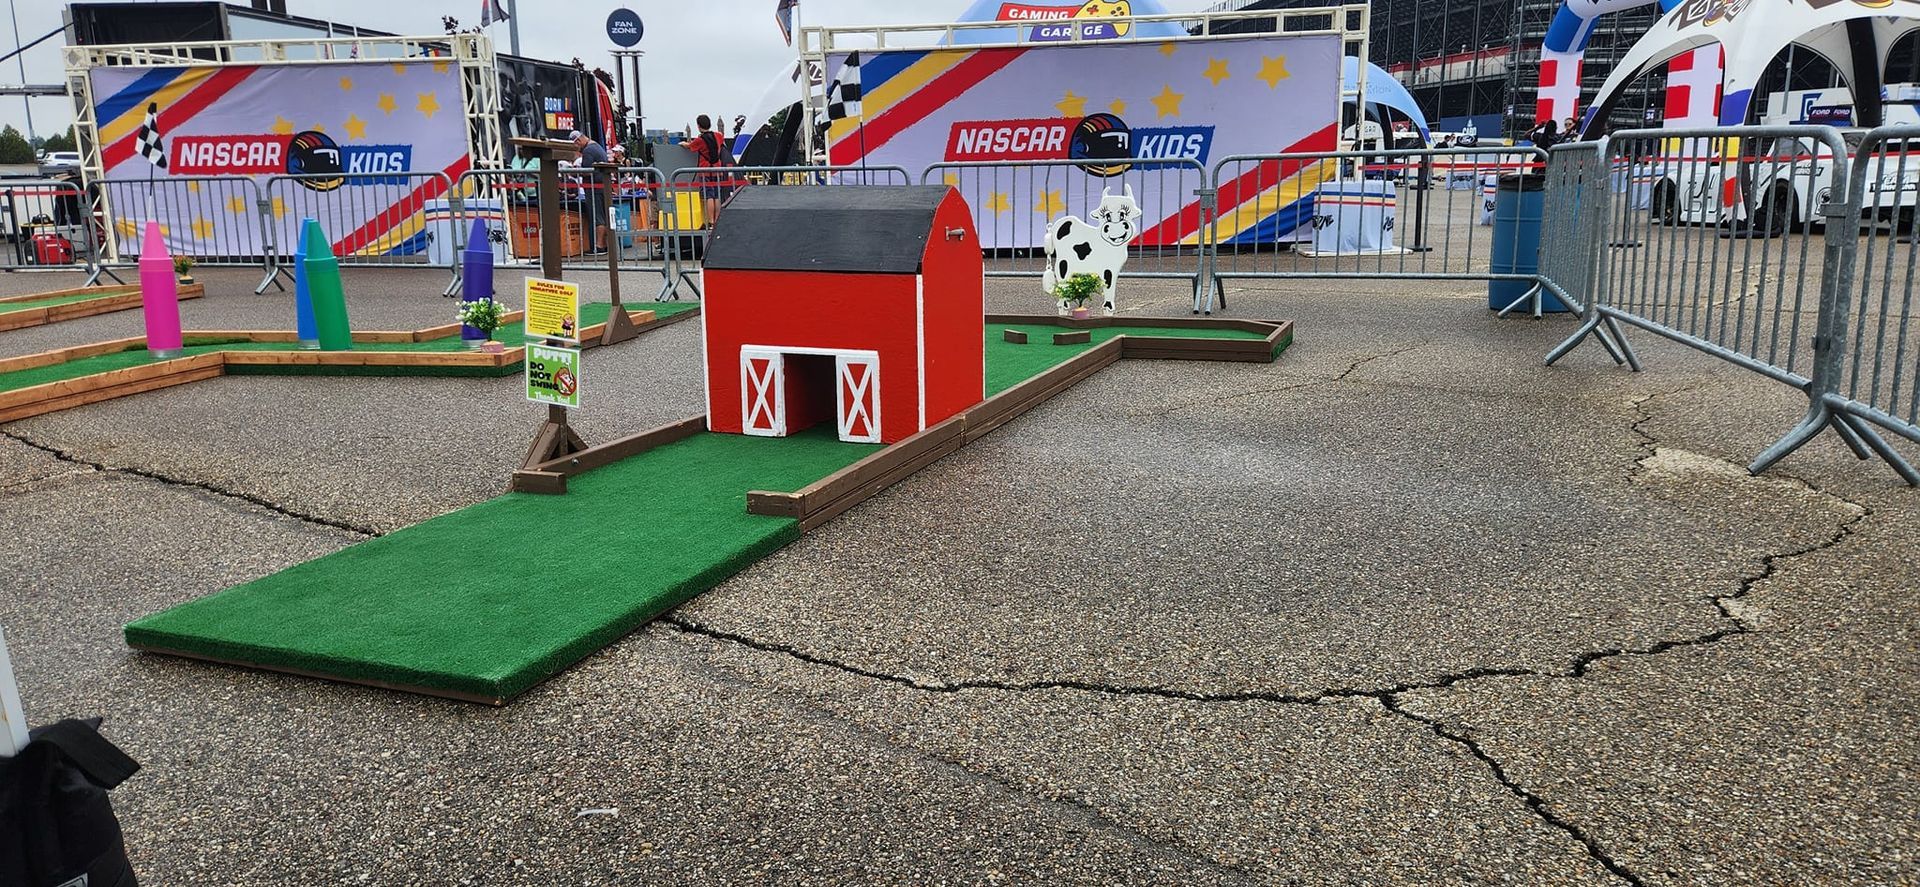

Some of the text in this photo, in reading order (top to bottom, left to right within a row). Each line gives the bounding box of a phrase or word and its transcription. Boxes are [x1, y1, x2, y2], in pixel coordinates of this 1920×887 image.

[1008, 9, 1069, 20] GAMING
[1041, 25, 1103, 37] GARGE
[544, 97, 562, 111] BORN
[557, 116, 574, 130] RACE
[956, 126, 1203, 159] NASCAR KIDS
[179, 142, 404, 174] NASCAR KIDS
[530, 361, 545, 371] DO
[530, 370, 552, 381] NOT
[530, 380, 559, 391] SWING
